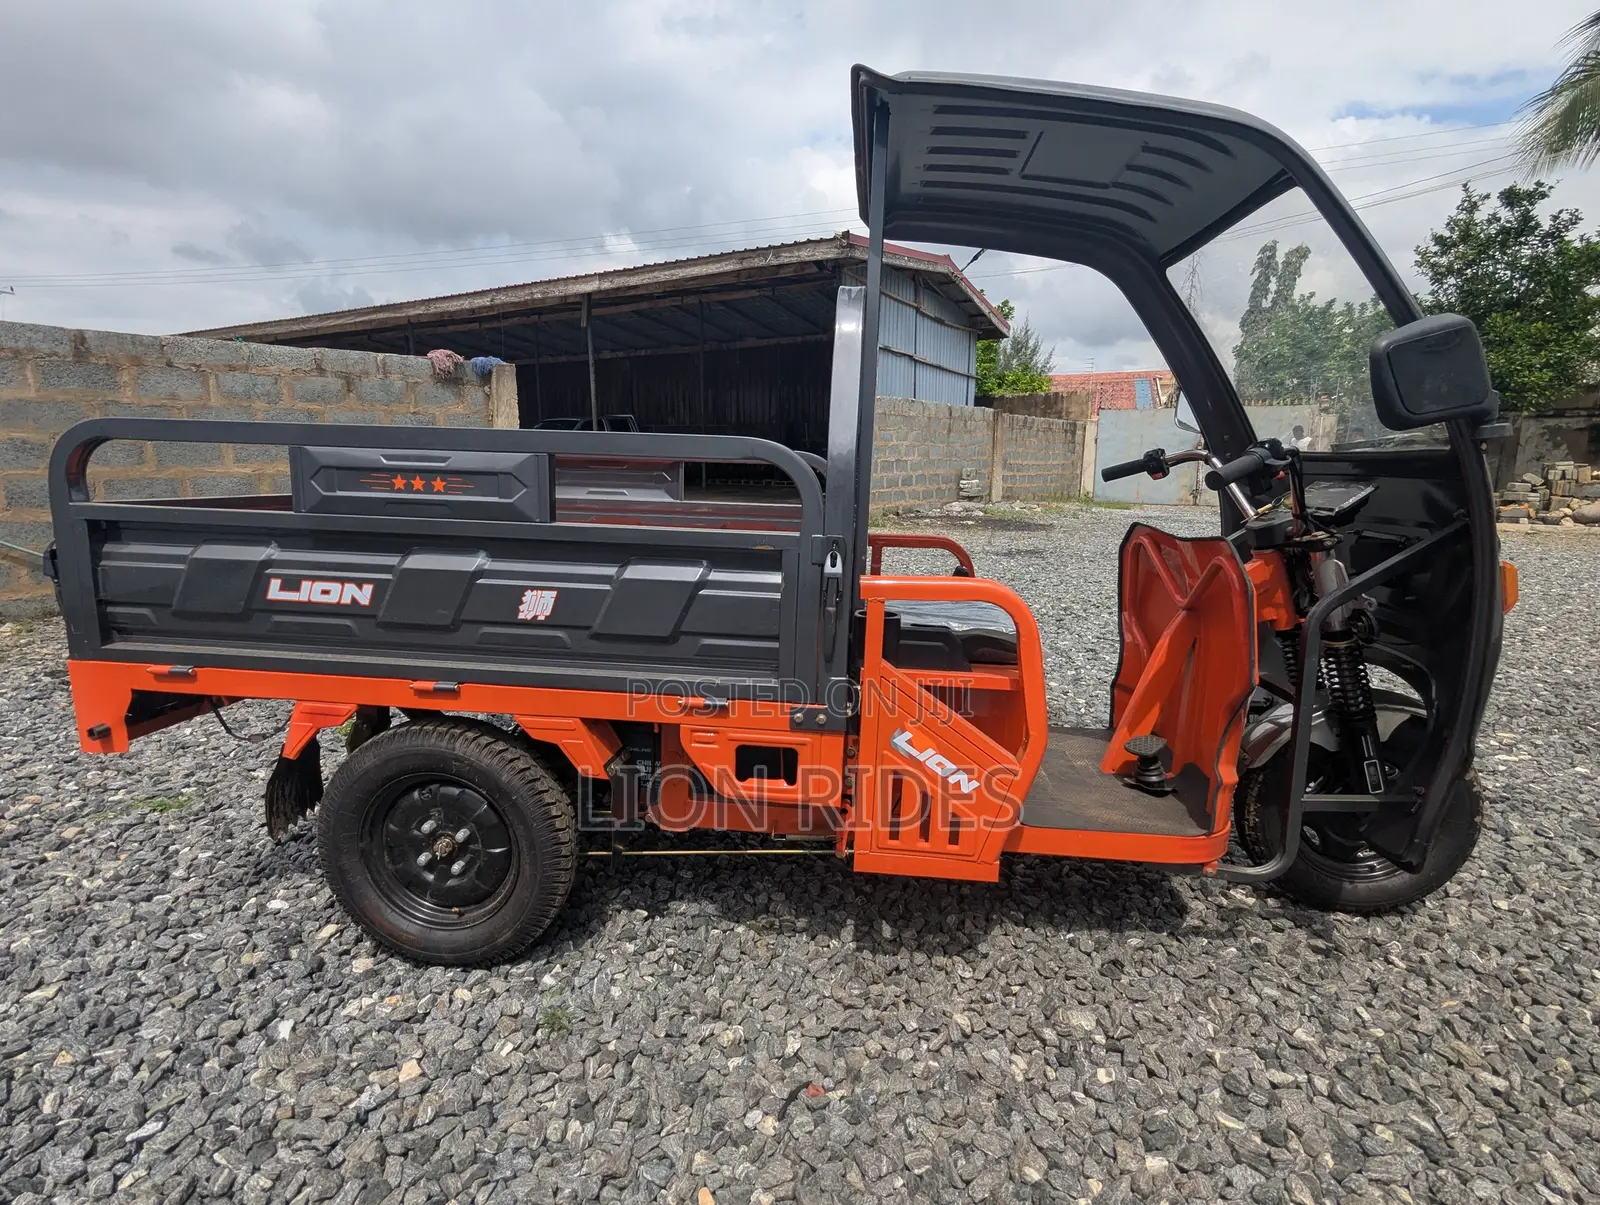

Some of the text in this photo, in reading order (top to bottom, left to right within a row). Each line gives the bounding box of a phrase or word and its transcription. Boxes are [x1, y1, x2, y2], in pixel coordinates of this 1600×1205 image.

[266, 577, 374, 606] LION
[517, 588, 558, 621] 狮
[891, 729, 981, 795] LION
